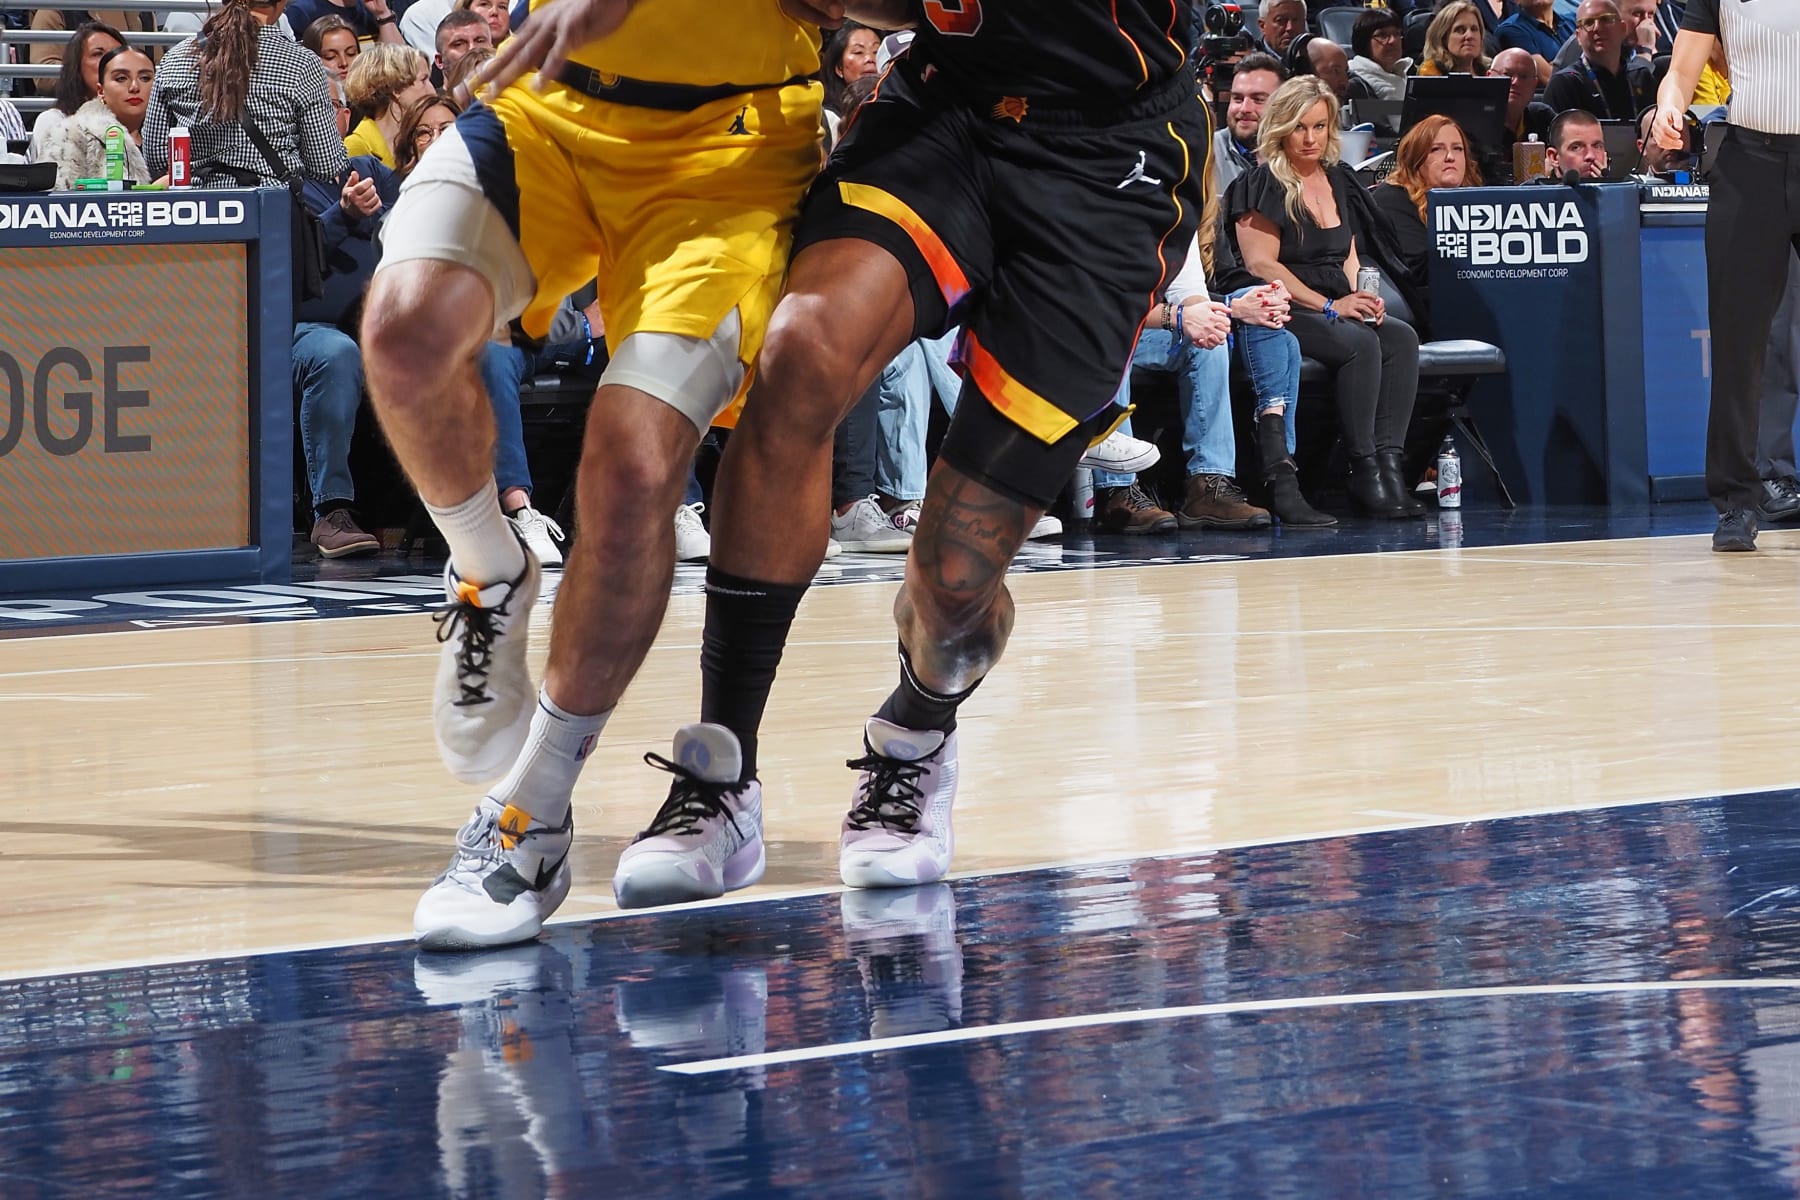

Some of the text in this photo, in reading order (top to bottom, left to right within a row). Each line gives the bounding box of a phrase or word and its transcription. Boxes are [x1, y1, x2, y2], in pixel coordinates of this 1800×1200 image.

[1652, 186, 1700, 198] INDIANA
[108, 202, 142, 214] FOR
[147, 200, 244, 226] BOLD
[108, 215, 142, 227] THE
[1435, 202, 1584, 231] INDIANA
[50, 231, 82, 239] ECONOMIC
[83, 230, 127, 238] DEVELOPMENT
[1436, 233, 1467, 246] FOR
[1437, 246, 1468, 258] THE
[1471, 230, 1589, 265] BOLD
[1457, 268, 1569, 279] ECONOMIC DEVELOPMENT CORP.
